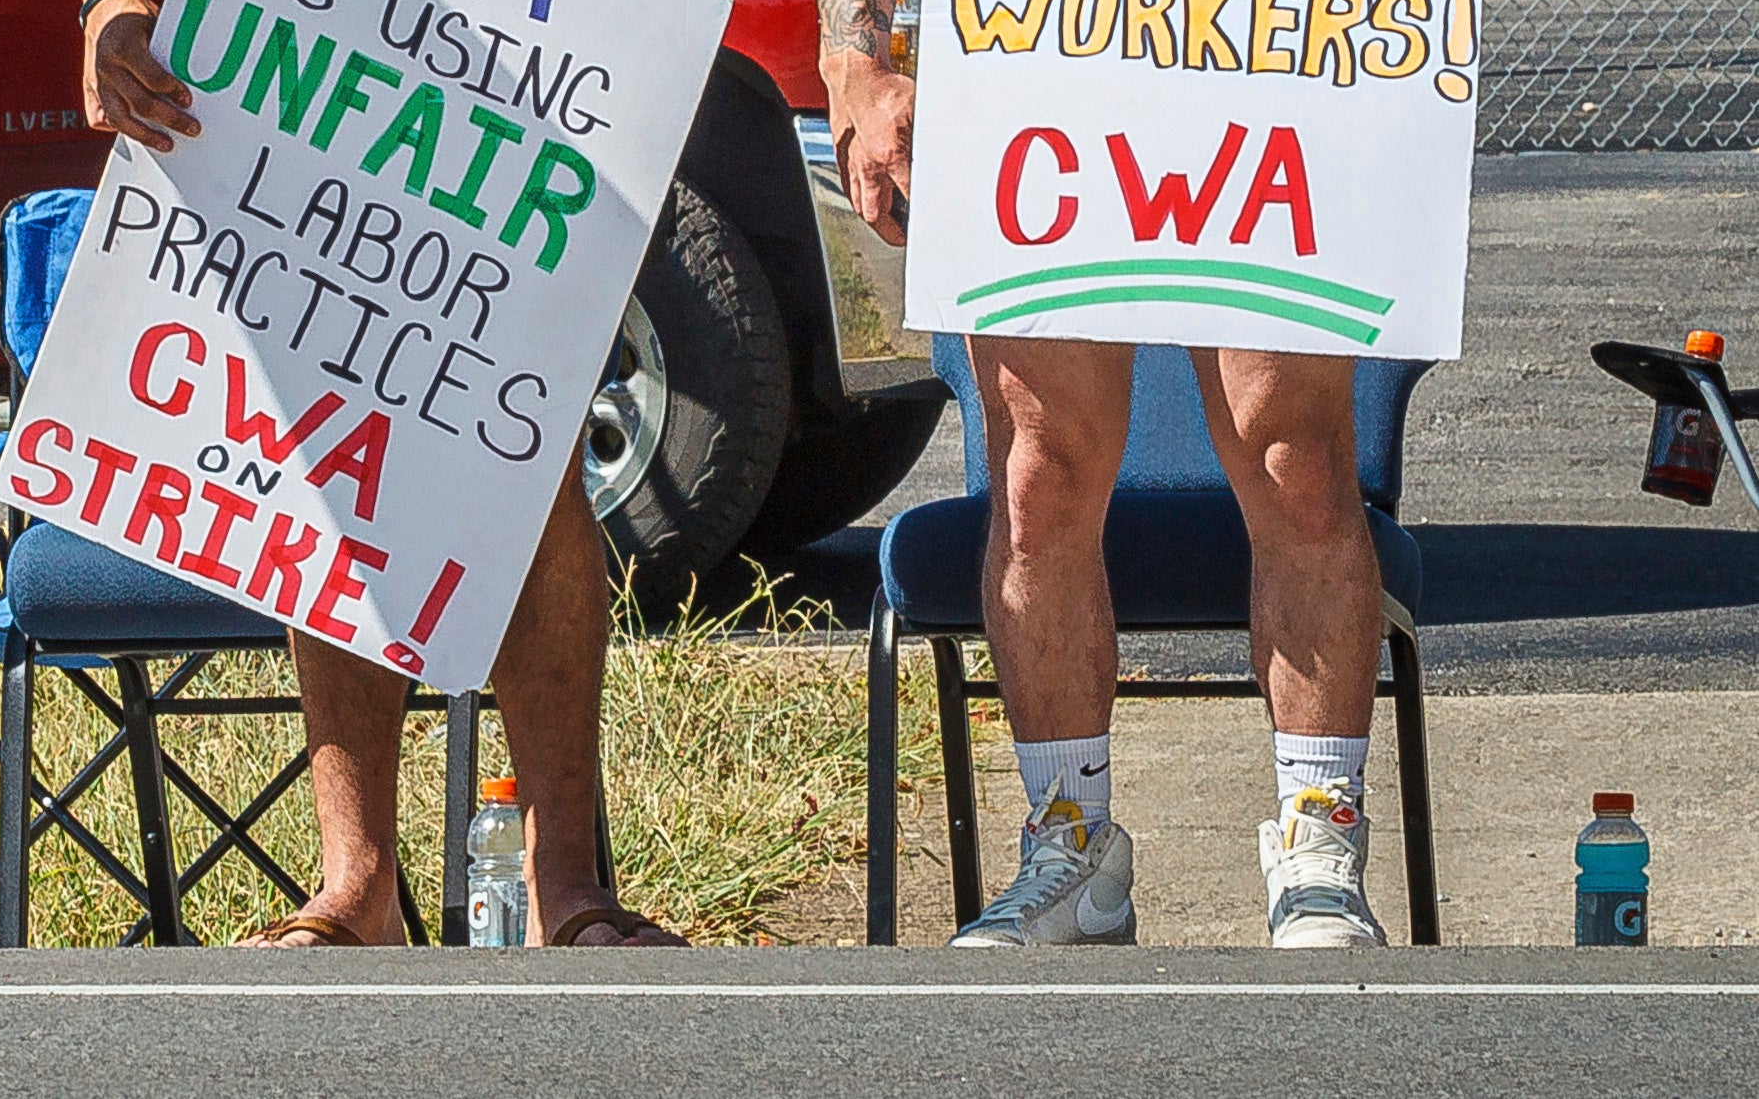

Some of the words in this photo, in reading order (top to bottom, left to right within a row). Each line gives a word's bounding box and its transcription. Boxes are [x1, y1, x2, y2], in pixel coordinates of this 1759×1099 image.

[995, 121, 1318, 257] CWA
[236, 145, 511, 342] LABOR
[101, 184, 548, 462] PRACTICES
[128, 320, 392, 522] CWA
[1677, 408, 1701, 436] G
[197, 443, 282, 497] ON
[469, 892, 489, 929] G
[1615, 901, 1640, 936] G
